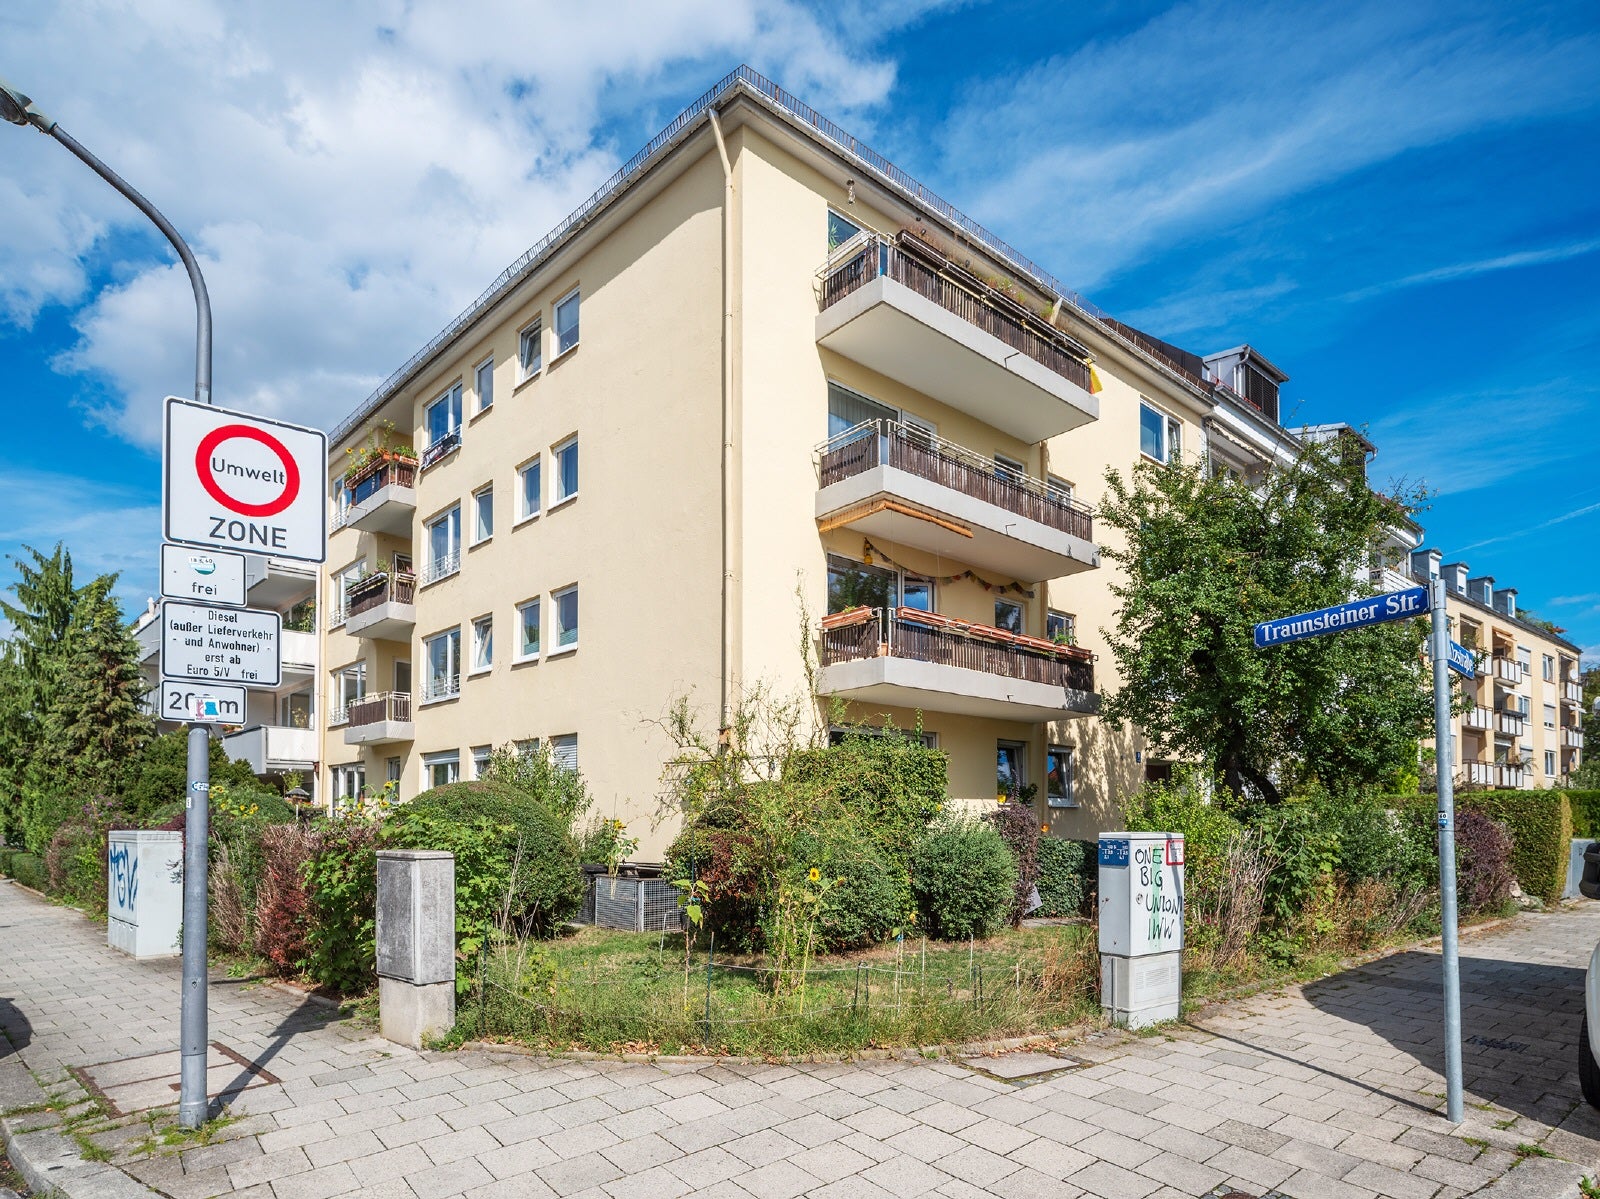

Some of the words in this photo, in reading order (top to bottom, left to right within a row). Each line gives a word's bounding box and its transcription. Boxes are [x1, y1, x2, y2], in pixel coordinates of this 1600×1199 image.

[212, 457, 285, 485] Umwelt
[209, 516, 287, 549] ZONE
[192, 581, 217, 596] frei
[208, 610, 238, 623] Diesel
[1261, 604, 1379, 642] Traunsteiner
[1385, 593, 1420, 615] Str.
[170, 619, 203, 633] (außer
[208, 624, 273, 641] Lieferverkehr
[185, 637, 203, 647] und
[208, 638, 260, 653] Anwohner)
[205, 653, 224, 663] erst
[229, 654, 241, 665] ab
[187, 664, 209, 676] Euro
[213, 666, 230, 678] 5/V
[241, 669, 258, 680] frei
[1135, 846, 1165, 865] ONE
[1140, 866, 1163, 891] BIG
